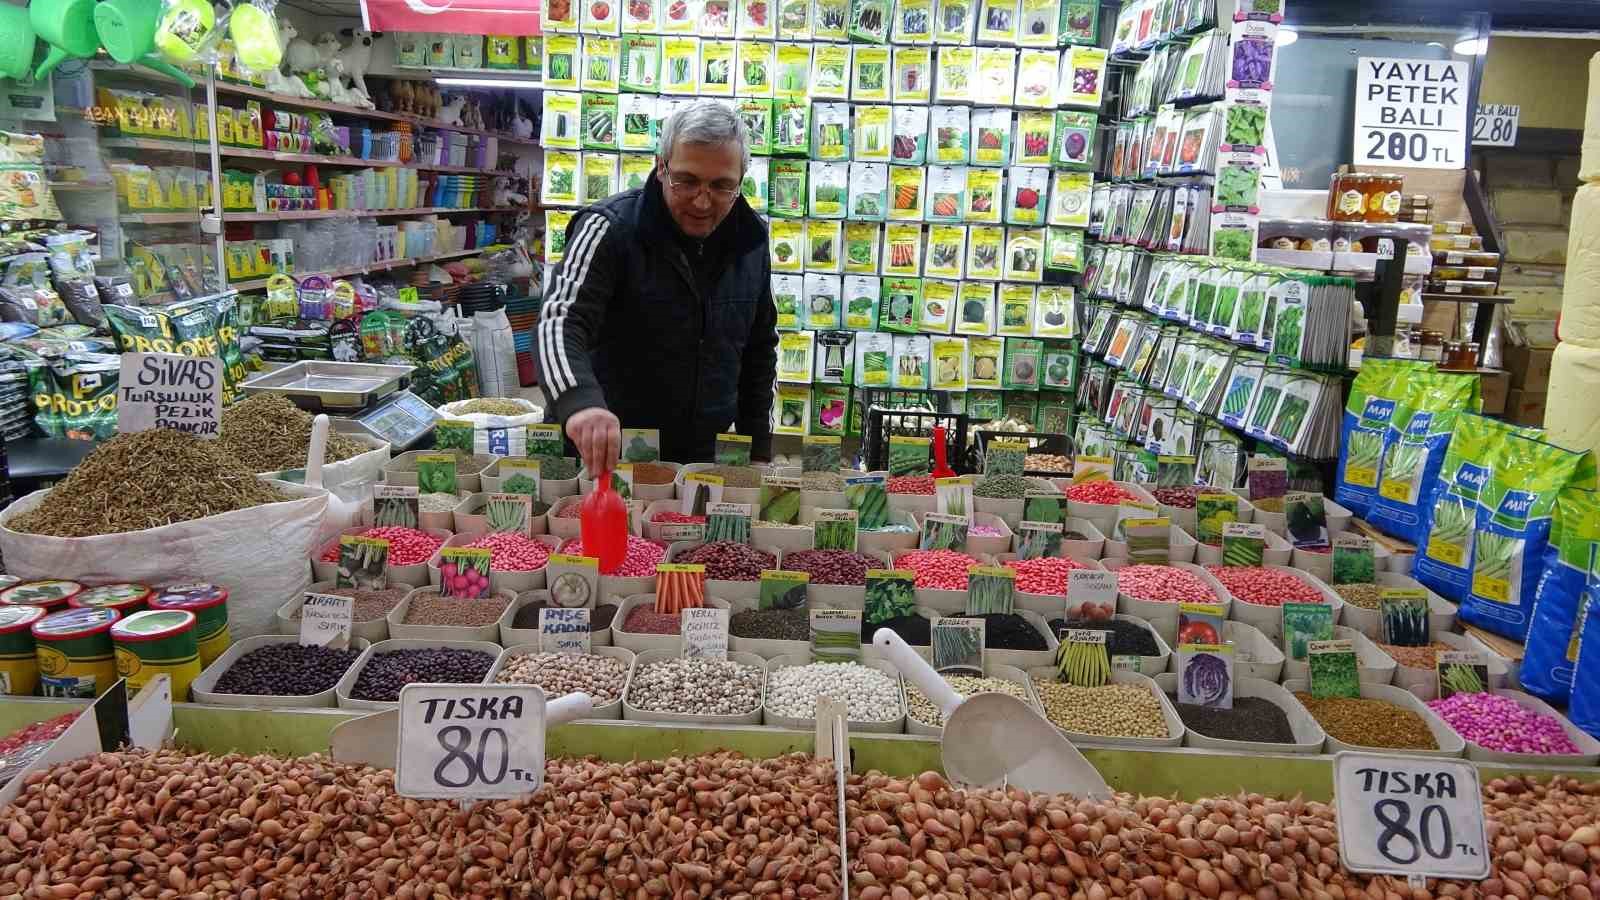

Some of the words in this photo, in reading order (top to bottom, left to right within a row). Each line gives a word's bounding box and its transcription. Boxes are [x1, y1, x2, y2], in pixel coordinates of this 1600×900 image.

[1369, 61, 1458, 83] YAYLA
[1368, 84, 1459, 105] PETEK
[1381, 106, 1443, 127] BALI
[1432, 148, 1455, 163] TL
[1367, 405, 1393, 419] MAY
[1411, 417, 1430, 430] MAY
[1458, 471, 1488, 485] MAY
[1504, 497, 1530, 511] MAY
[419, 695, 523, 724] TISKA
[433, 725, 509, 788] 80
[509, 768, 534, 782] TL
[1354, 768, 1457, 799] TISKA
[1374, 798, 1453, 865] 80
[1455, 843, 1478, 856] TL
